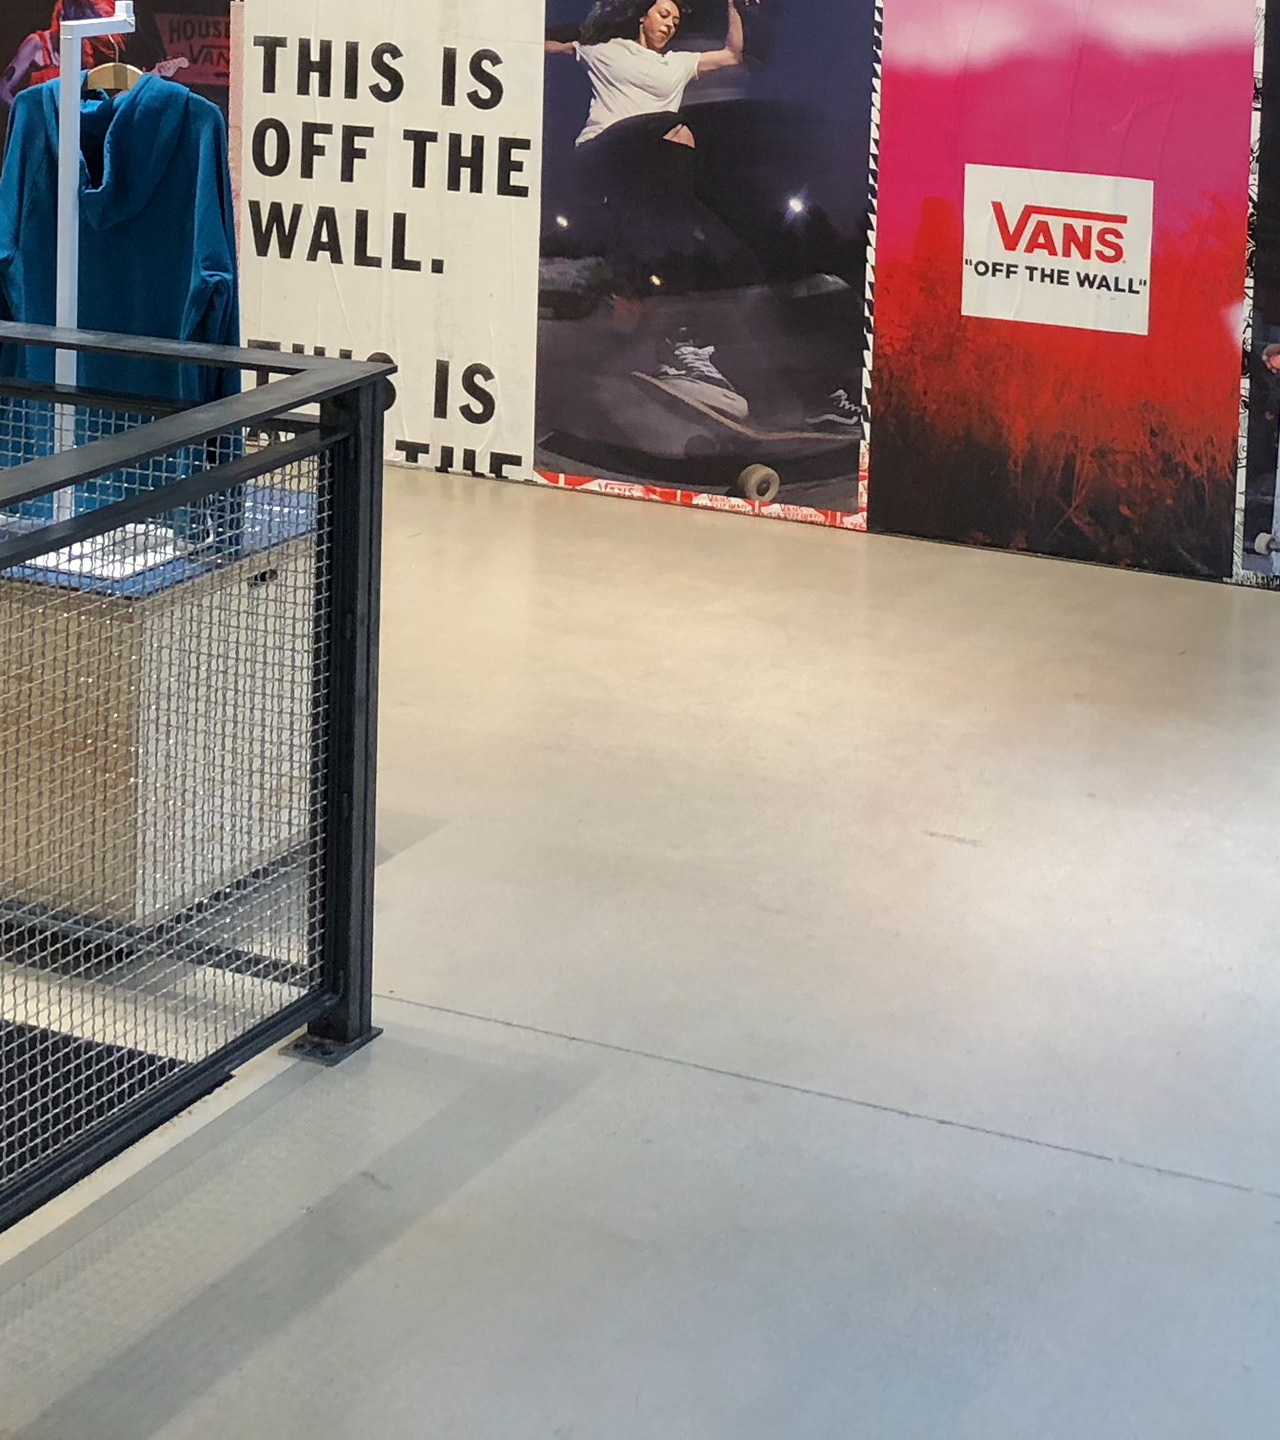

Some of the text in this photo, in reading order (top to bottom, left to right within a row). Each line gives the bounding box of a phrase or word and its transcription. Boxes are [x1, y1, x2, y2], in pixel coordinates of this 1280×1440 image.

[253, 36, 503, 110] THIS IS
[251, 118, 531, 196] OFF THE
[248, 199, 445, 273] WALL.
[991, 201, 1127, 264] VANS
[965, 259, 1147, 294] "OFF THE WALL"
[434, 359, 496, 424] IS
